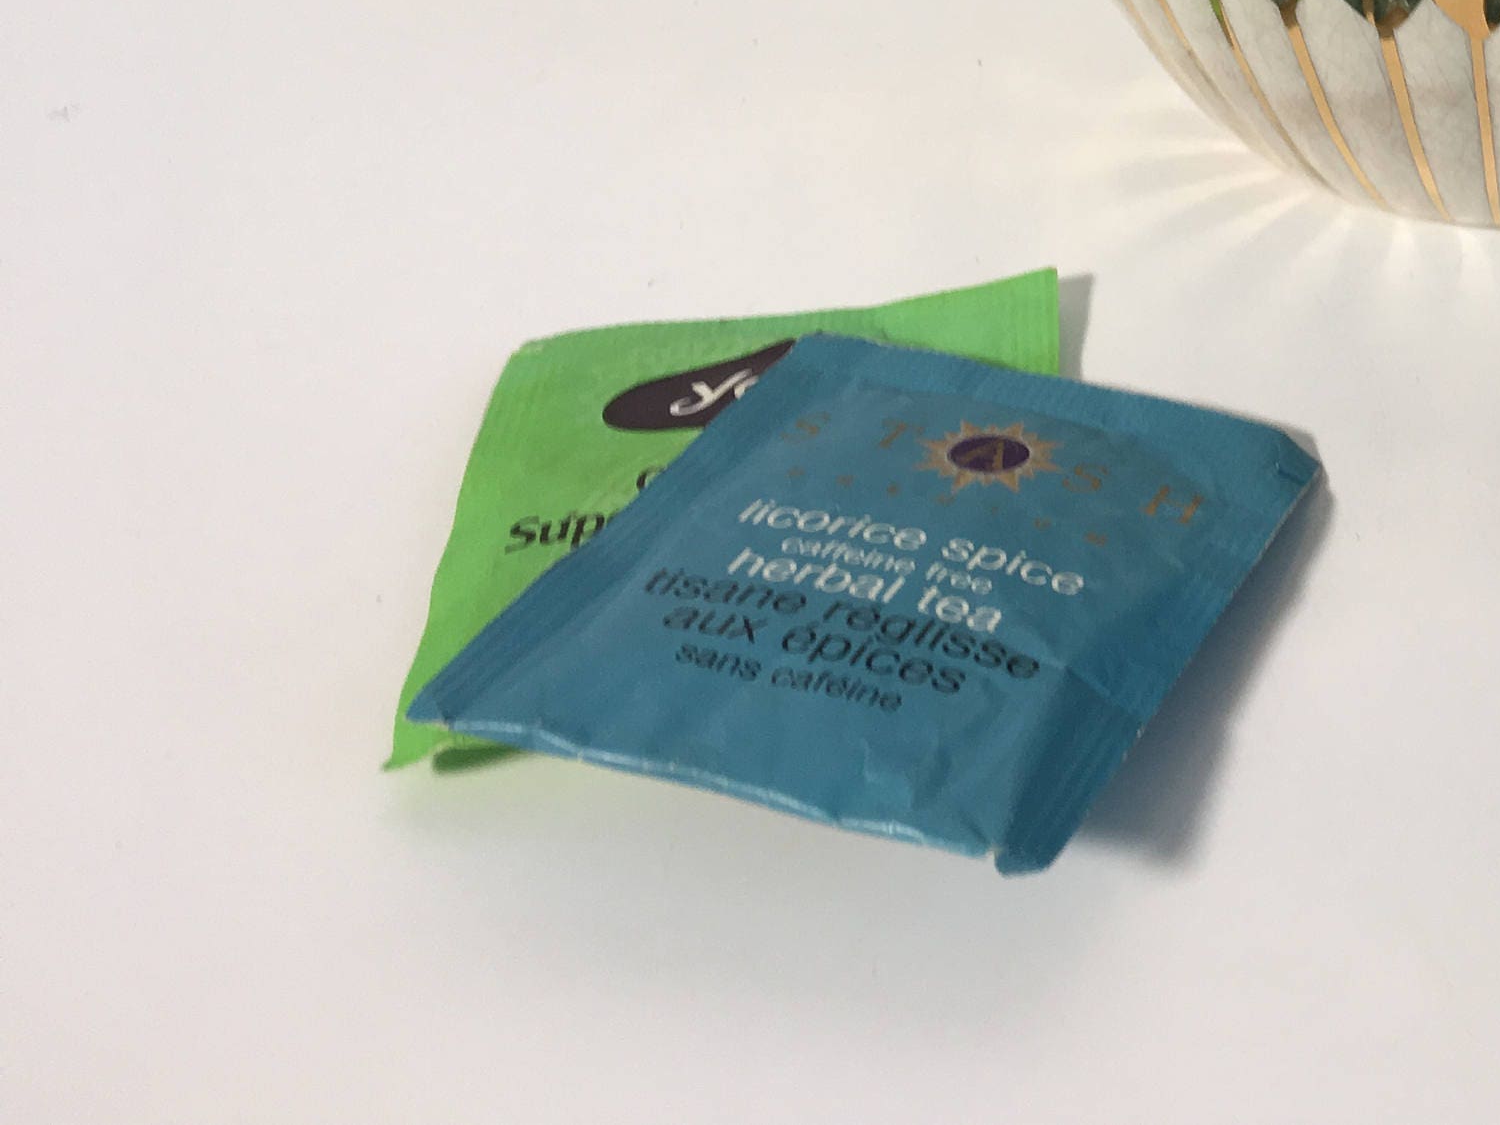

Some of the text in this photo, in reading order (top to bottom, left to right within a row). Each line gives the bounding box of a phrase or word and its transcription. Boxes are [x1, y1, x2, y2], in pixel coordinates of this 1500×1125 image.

[504, 511, 617, 555] Sup
[738, 498, 927, 551] licorice
[940, 537, 1085, 596] spice
[781, 535, 993, 596] caffeine free
[645, 567, 1041, 679] tisane réglisse
[727, 546, 1002, 634] herbal tea
[663, 605, 966, 694] aux épices
[675, 642, 762, 682] sans
